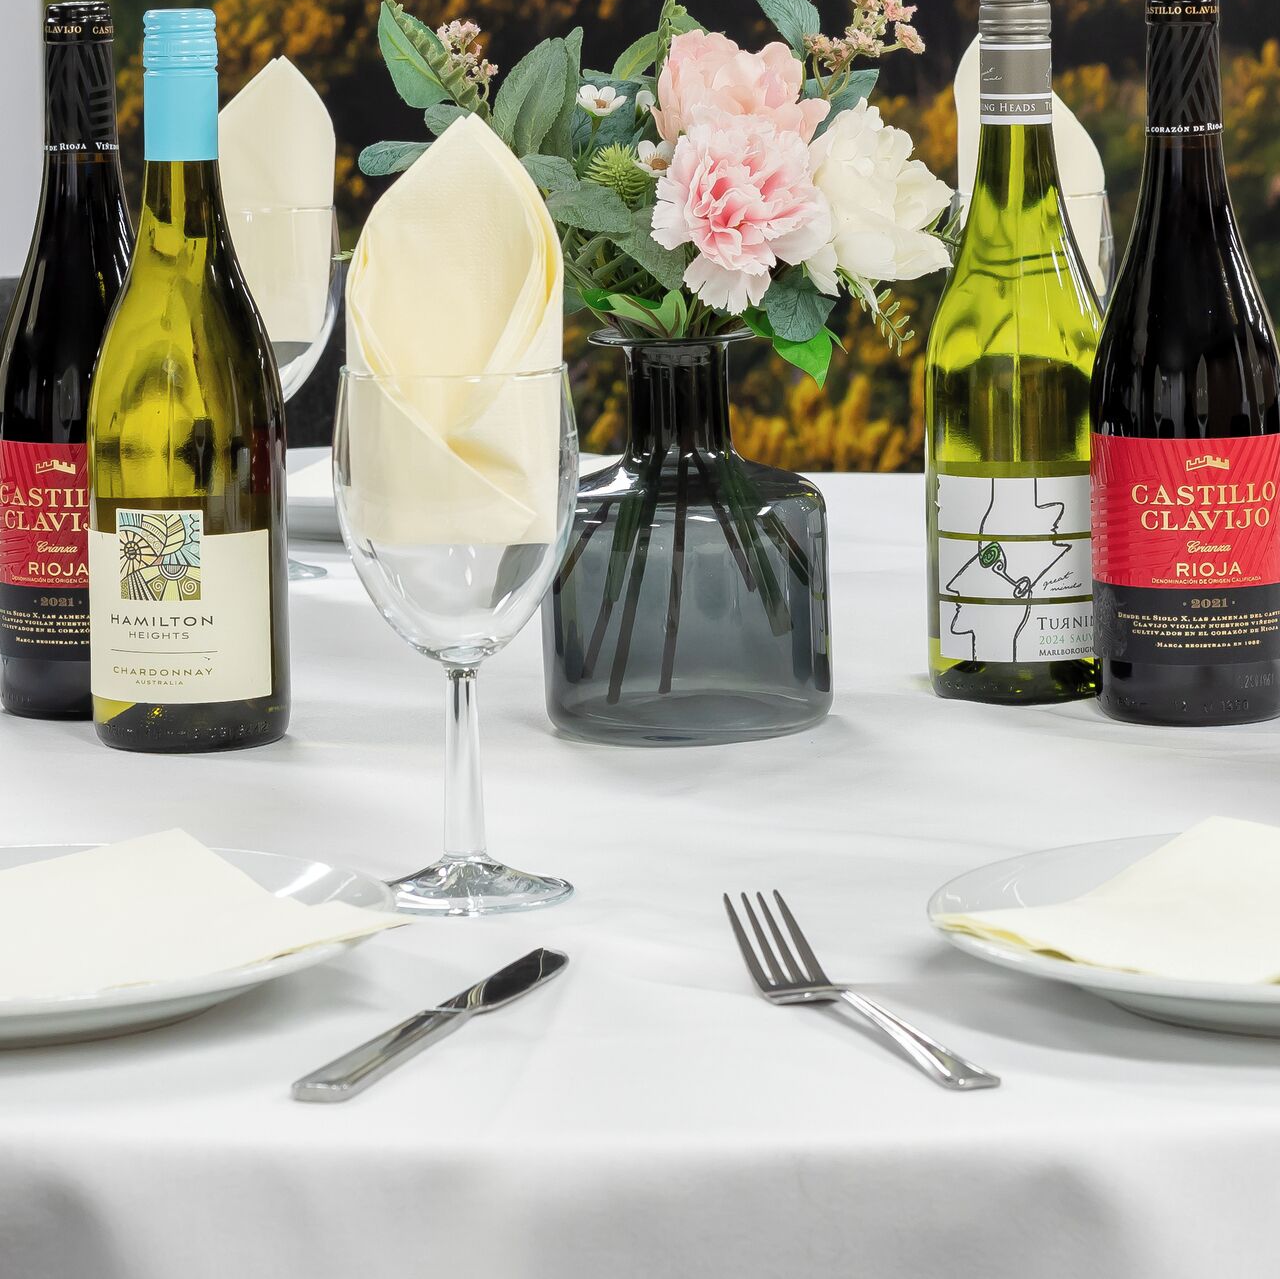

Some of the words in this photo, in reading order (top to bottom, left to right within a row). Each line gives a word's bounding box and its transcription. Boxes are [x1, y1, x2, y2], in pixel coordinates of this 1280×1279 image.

[1131, 480, 1277, 506] CASTILLO
[1140, 506, 1270, 531] CLAVIJO
[36, 540, 78, 554] Crianza
[1186, 540, 1232, 554] Crianza
[28, 561, 89, 577] RIOJA
[1176, 561, 1242, 577] RIOJA
[1042, 571, 1074, 591] great
[1049, 582, 1083, 592] minds
[40, 596, 74, 607] 2021
[1190, 598, 1229, 609] 2021
[110, 613, 214, 627] HAMILTON
[128, 631, 190, 640] HEIGHTS
[1039, 634, 1065, 645] 2024
[113, 665, 213, 677] CHARDONNAY
